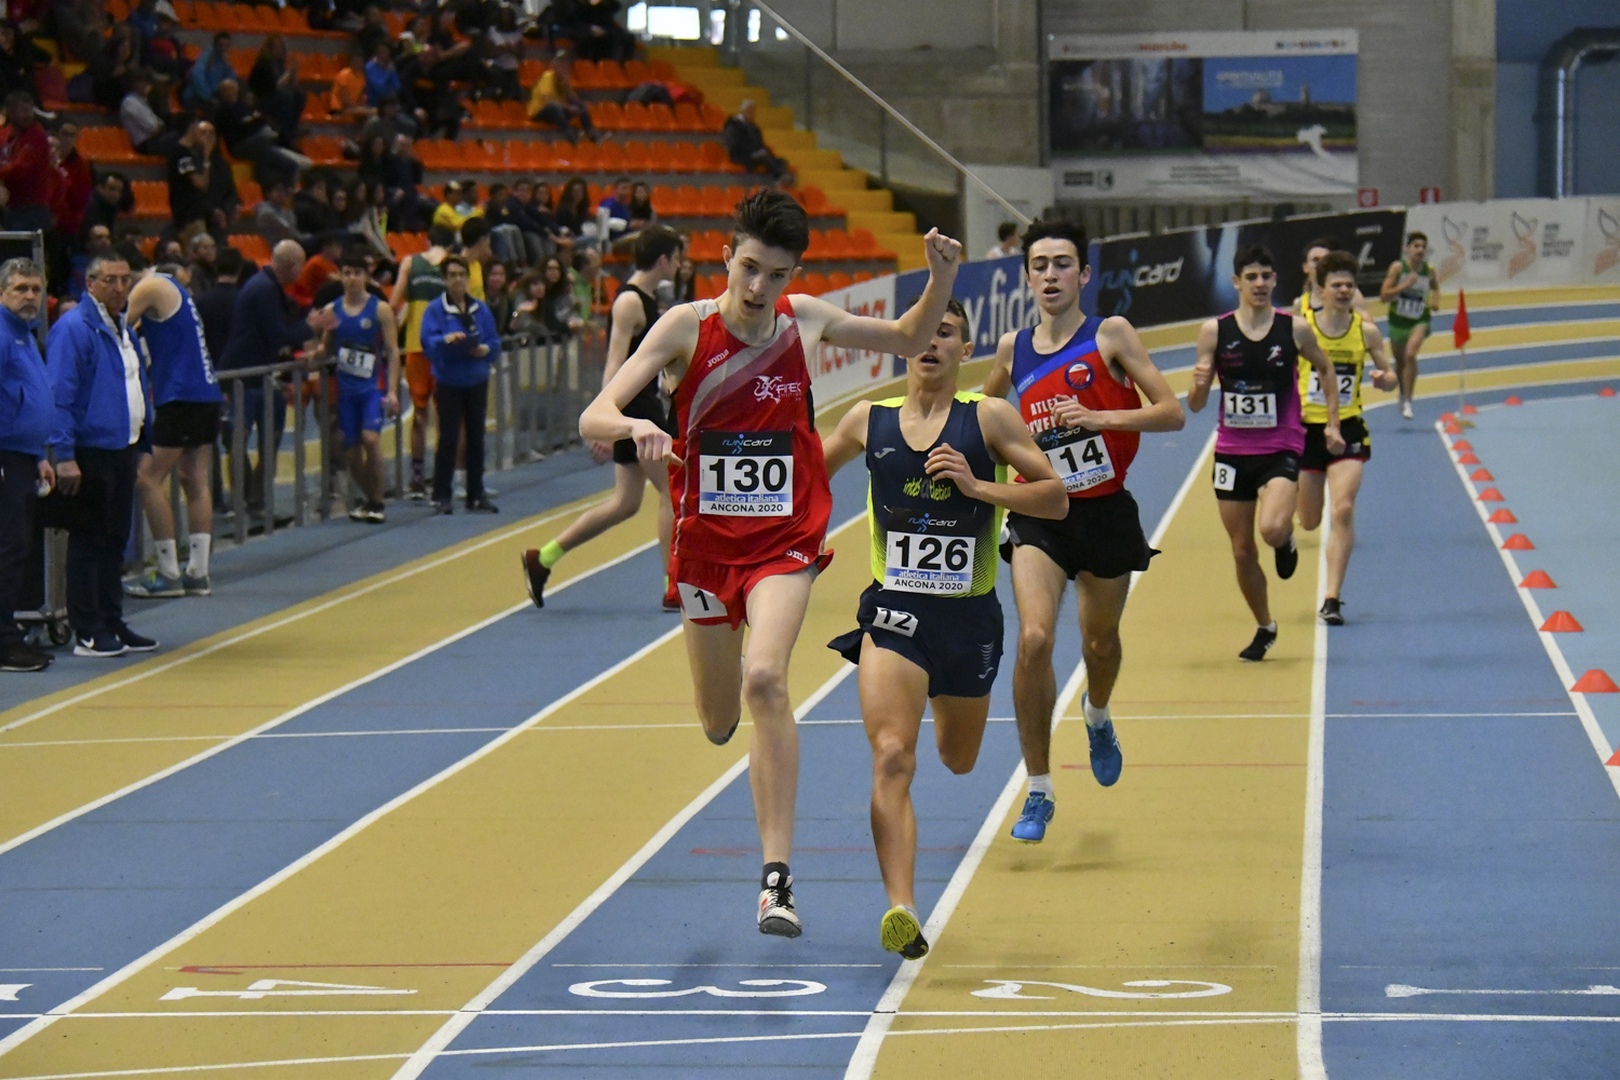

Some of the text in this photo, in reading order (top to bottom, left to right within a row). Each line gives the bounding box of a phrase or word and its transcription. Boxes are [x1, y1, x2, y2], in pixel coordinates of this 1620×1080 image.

[1314, 377, 1352, 394] 12
[1229, 395, 1269, 414] 131
[709, 458, 787, 493] 130
[1066, 483, 1085, 491] ONA
[1087, 474, 1108, 485] 2020
[1219, 468, 1227, 484] 8
[714, 493, 779, 503] atletica italiana
[710, 503, 783, 512] ANCONA 2020
[786, 549, 809, 564] oma
[895, 535, 969, 572] 126
[898, 570, 960, 581] atletica italiana
[894, 578, 963, 591] ANCONA 2020
[694, 589, 710, 611] 1
[881, 608, 912, 631] 12
